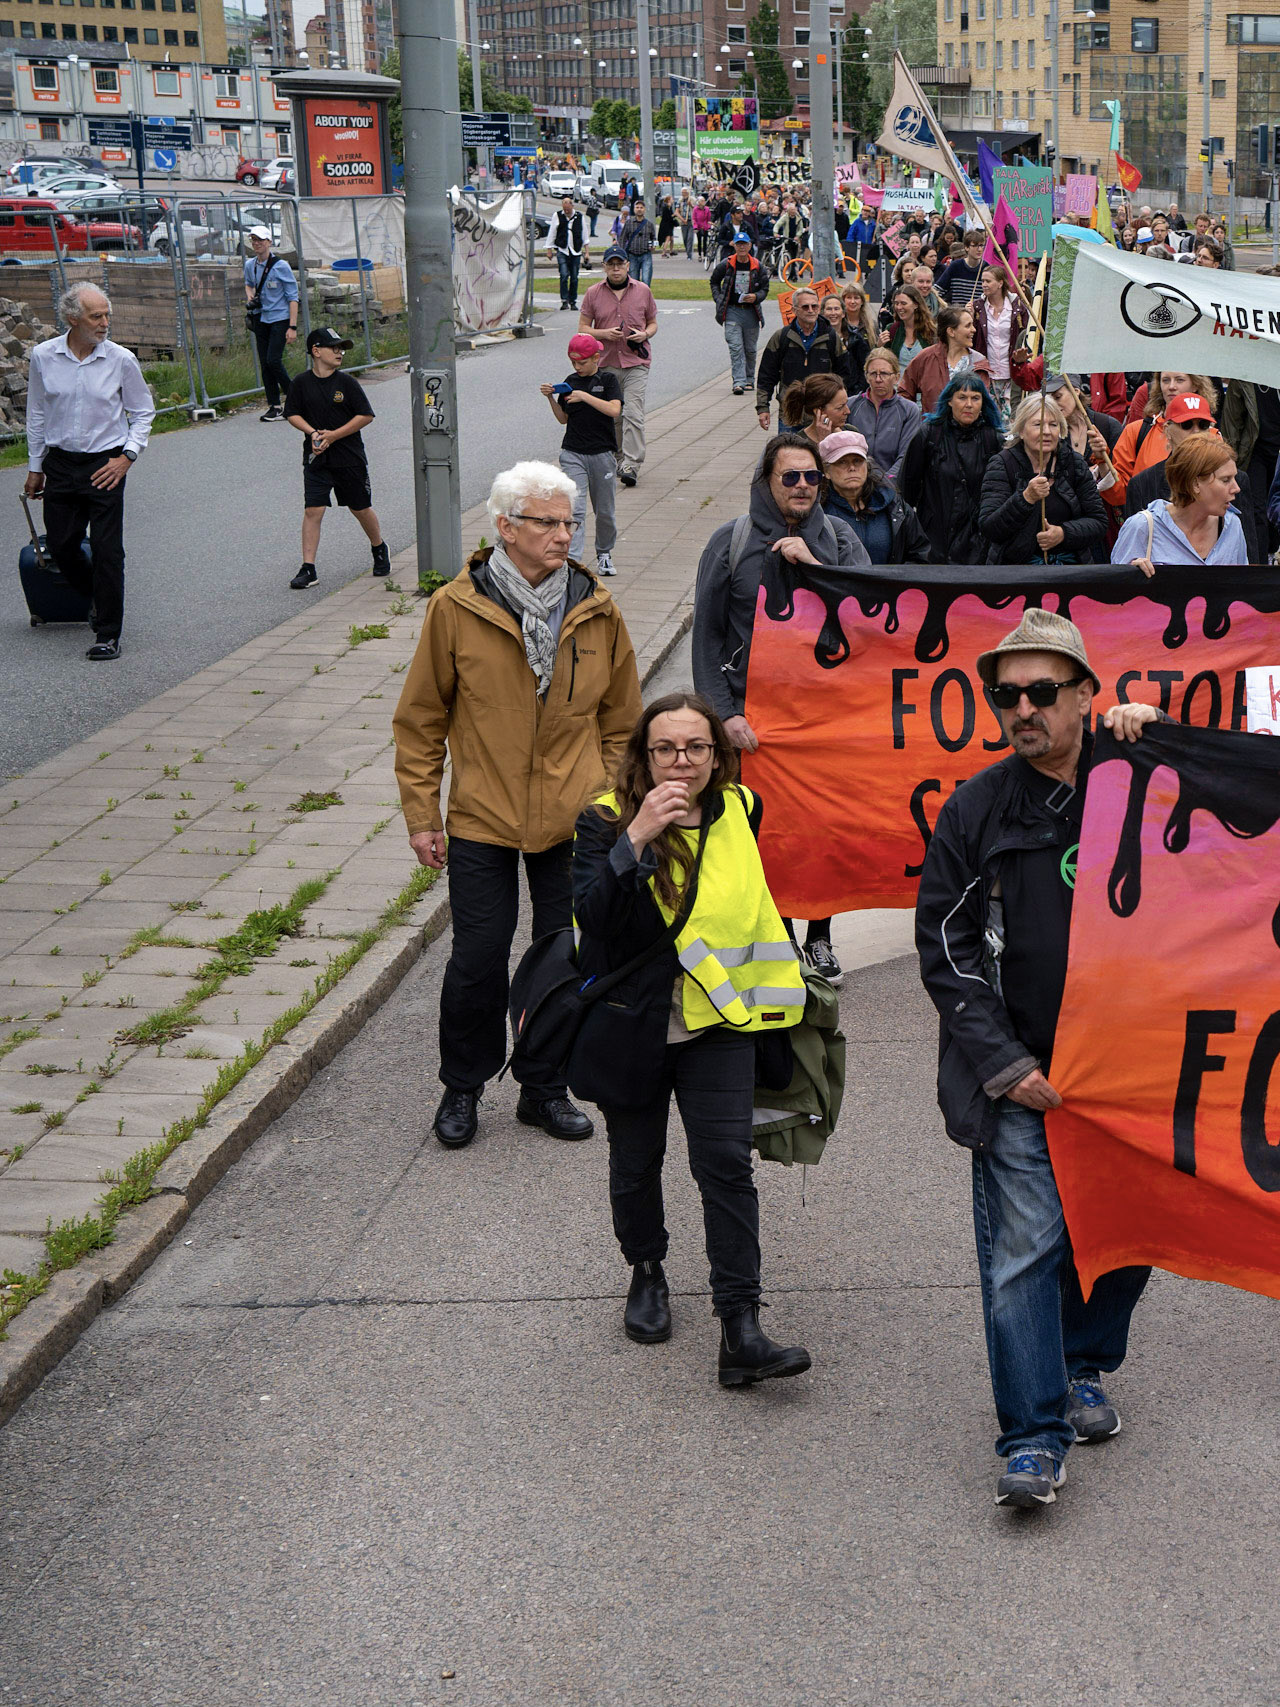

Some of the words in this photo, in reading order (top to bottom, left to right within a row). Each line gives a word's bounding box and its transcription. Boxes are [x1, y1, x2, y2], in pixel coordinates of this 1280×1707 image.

[315, 115, 348, 127] ABOUT
[700, 136, 711, 144] Här
[713, 136, 744, 145] utvecklas
[700, 147, 755, 157] Masthuggskajen
[326, 163, 372, 176] 500.000
[995, 169, 1020, 178] TALA
[884, 188, 945, 200] HUSHÅLLNIN
[1013, 206, 1045, 227] GERA
[1183, 397, 1201, 409] W
